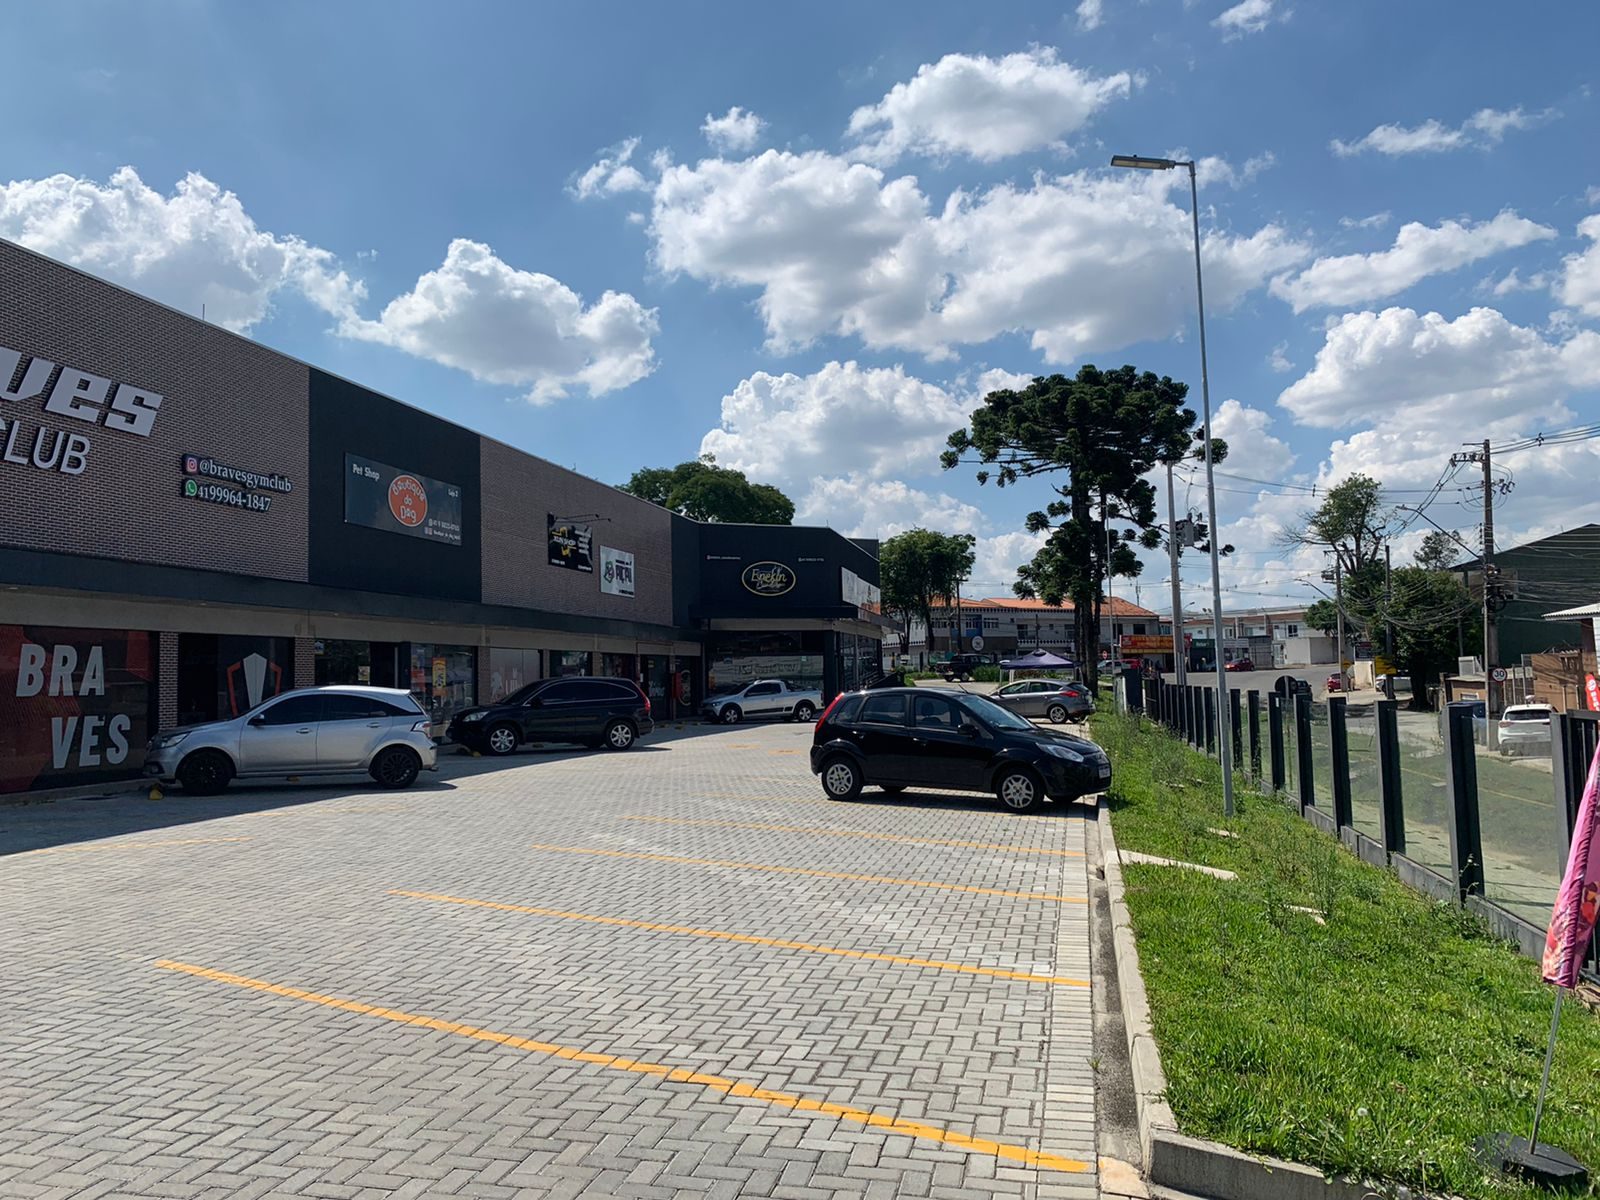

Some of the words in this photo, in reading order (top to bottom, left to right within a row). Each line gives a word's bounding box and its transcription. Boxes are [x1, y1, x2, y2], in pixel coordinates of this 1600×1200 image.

[0, 417, 91, 475] LUB
[352, 463, 363, 476] Pet
[364, 466, 380, 482] Shop
[199, 459, 292, 492] @bravesgymclub
[16, 643, 105, 698] BRA
[51, 714, 131, 769] VES
